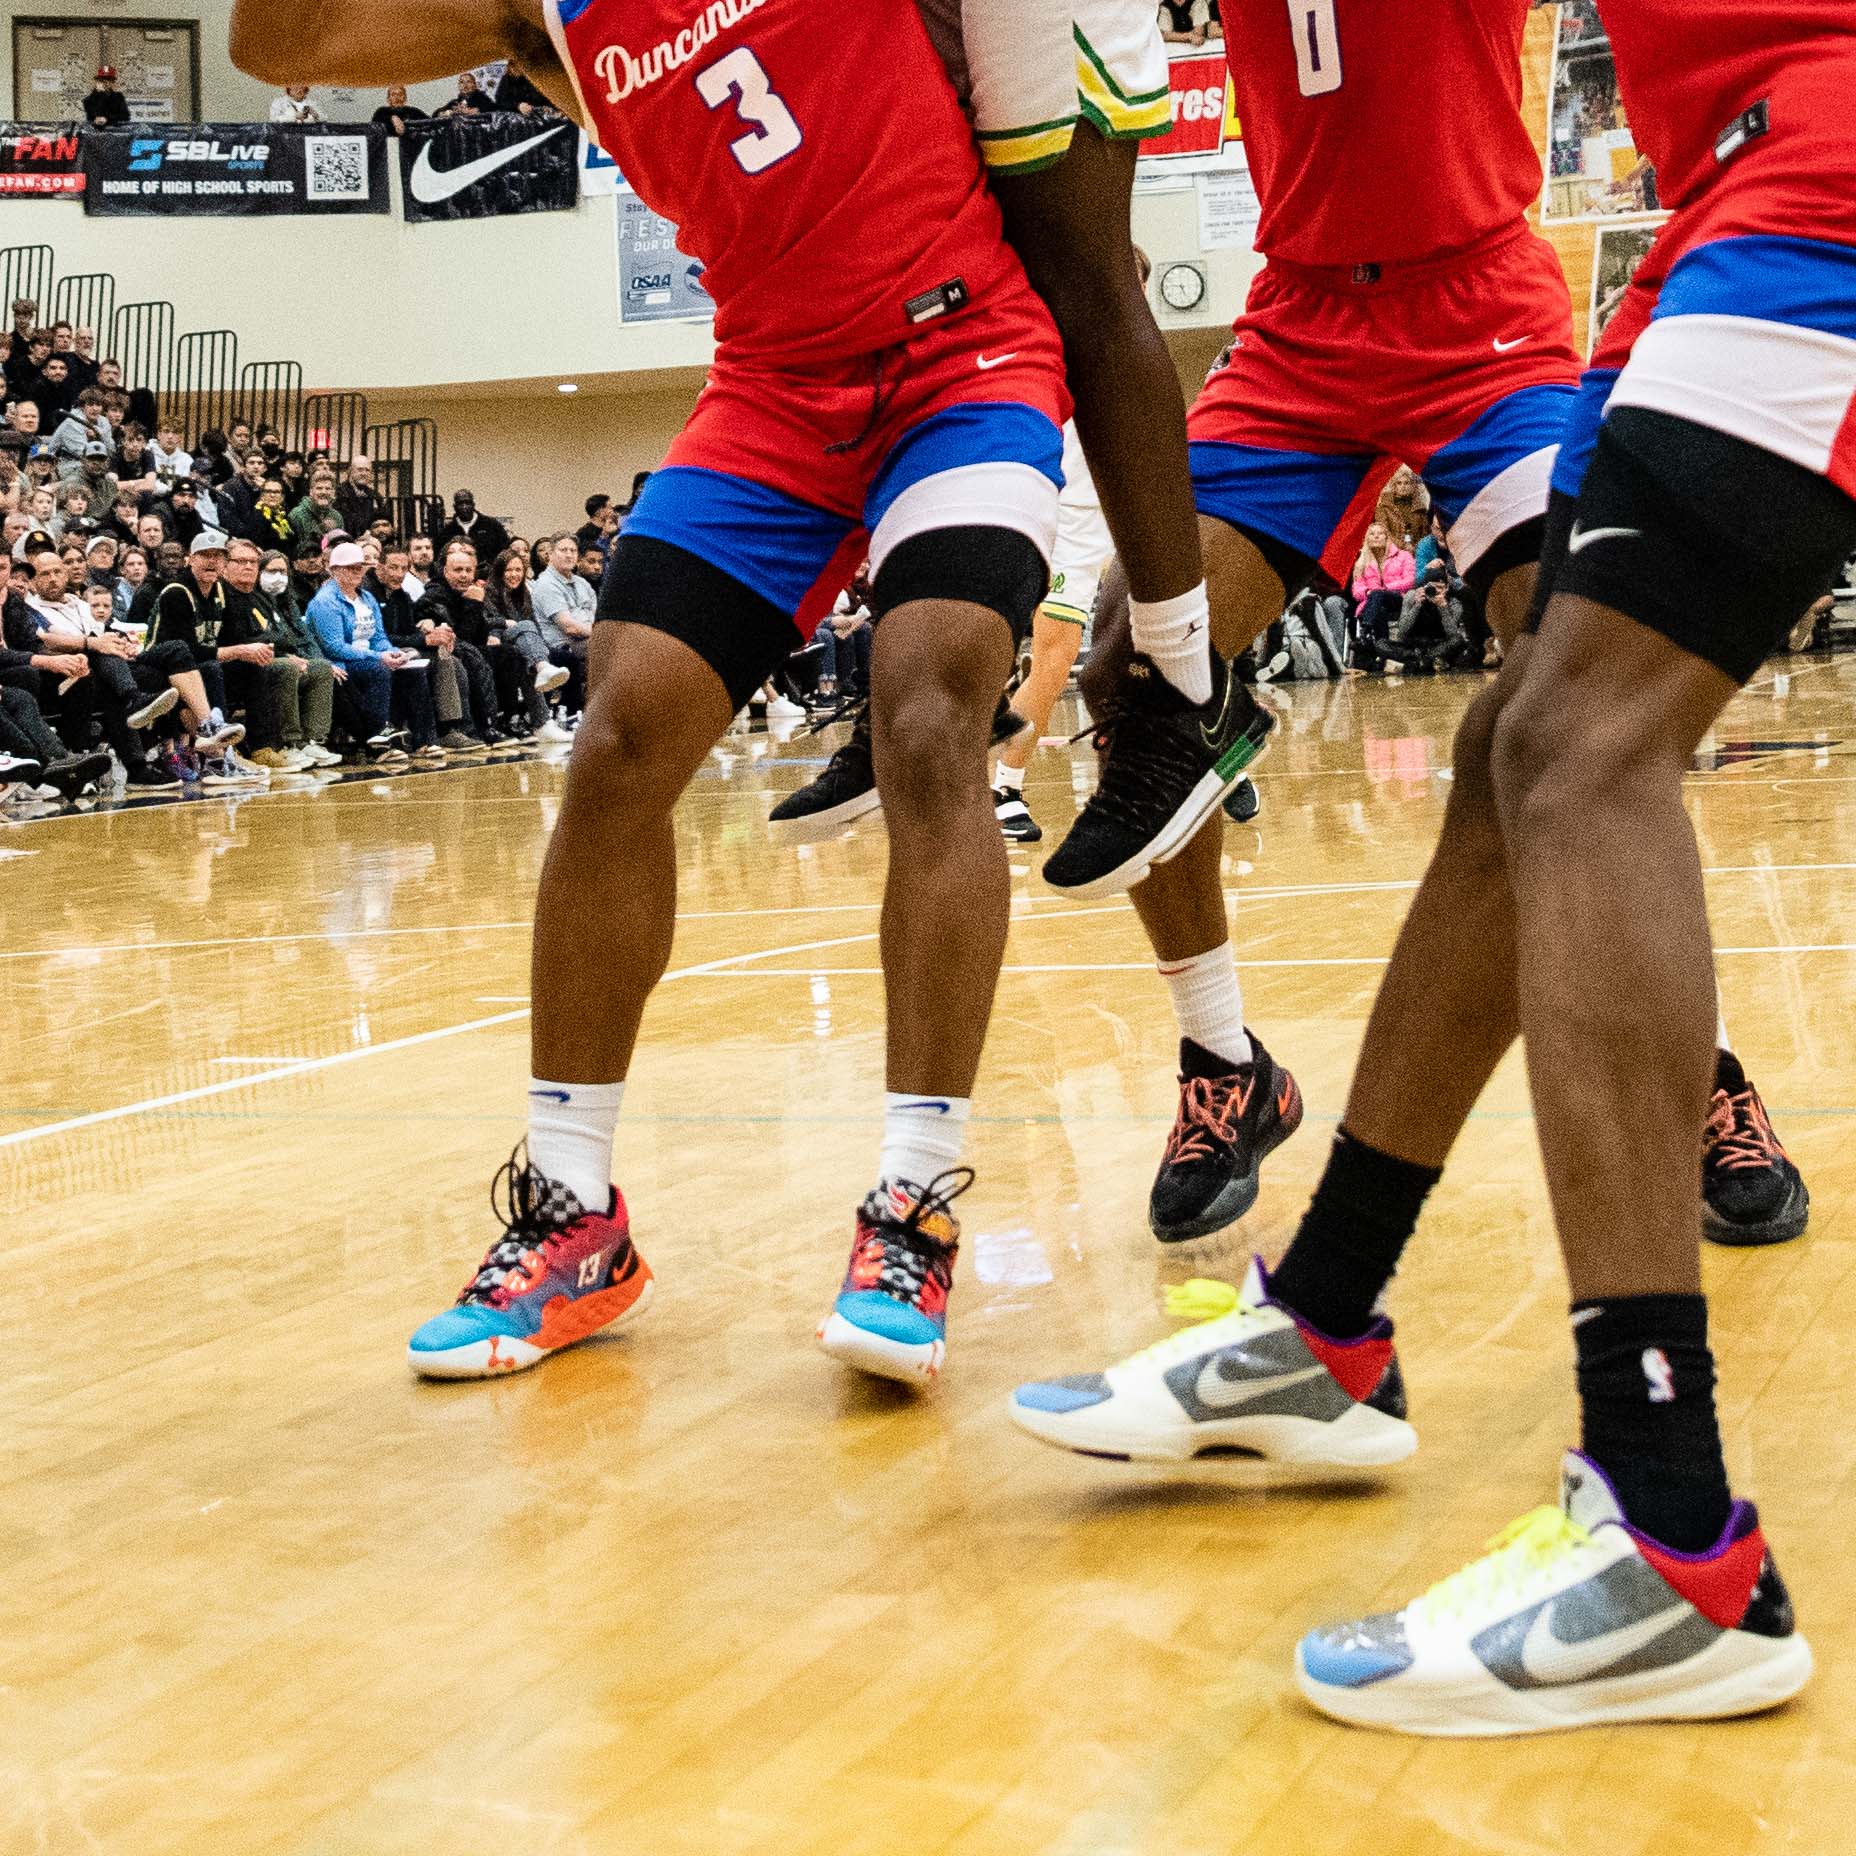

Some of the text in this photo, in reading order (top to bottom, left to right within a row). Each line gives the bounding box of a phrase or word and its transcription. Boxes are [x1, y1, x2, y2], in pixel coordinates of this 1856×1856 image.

[694, 45, 804, 176] 3
[1171, 86, 1223, 123] res
[13, 137, 79, 161] FAN
[102, 179, 294, 195] HOME OF HIGH SCHOOL SPORTS
[631, 274, 672, 290] OSAA
